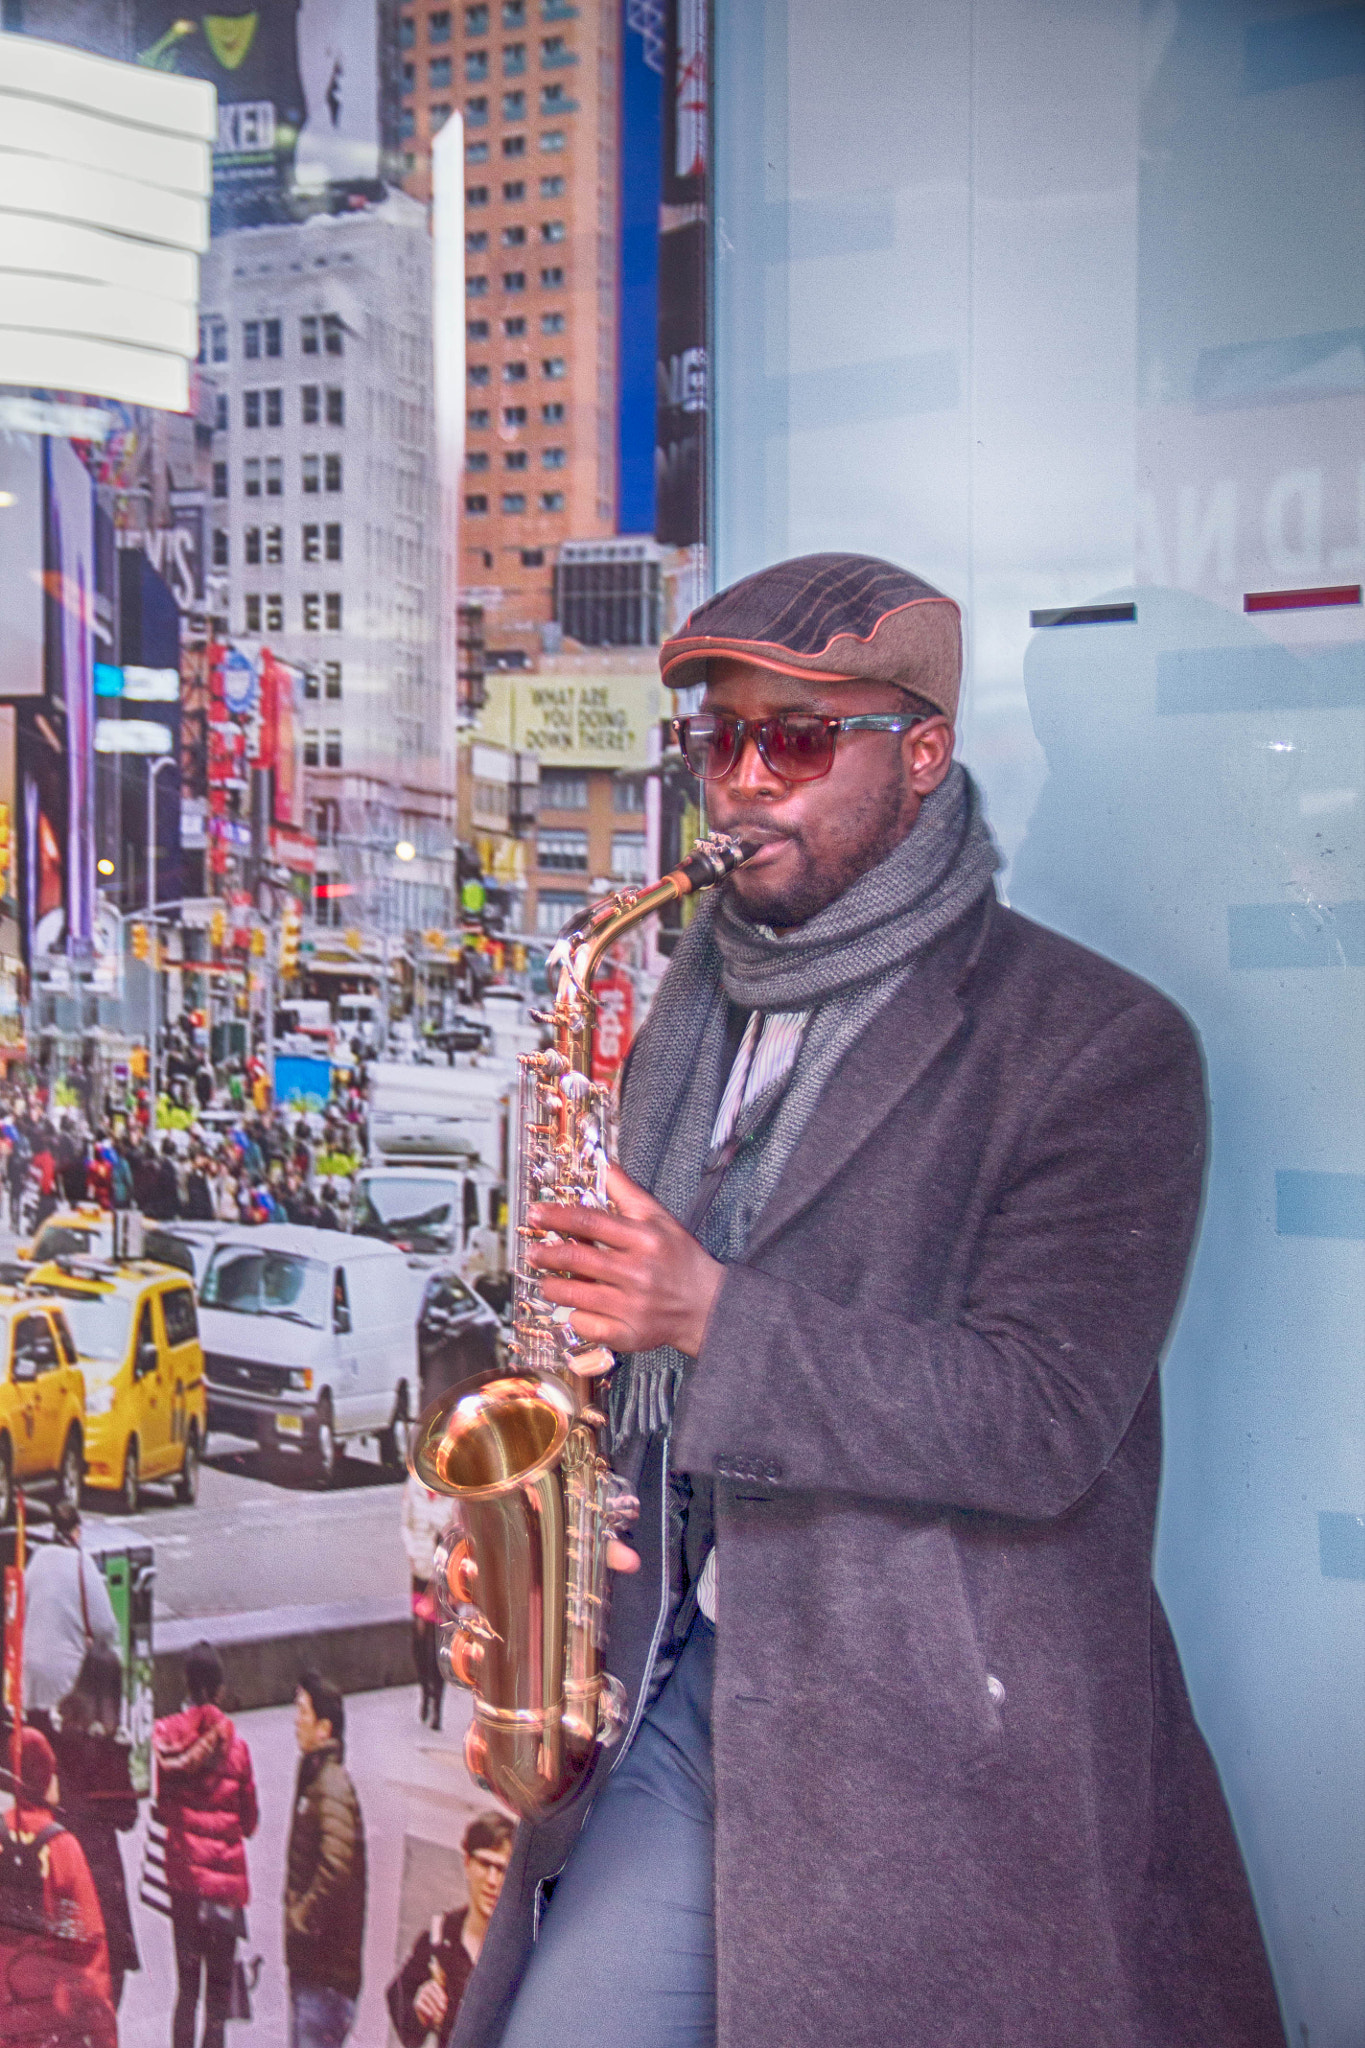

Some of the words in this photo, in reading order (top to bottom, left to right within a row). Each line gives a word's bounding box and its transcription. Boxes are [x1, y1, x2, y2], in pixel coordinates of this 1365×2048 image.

[530, 686, 575, 706] WHAT
[579, 686, 609, 706] ARE
[543, 708, 573, 728] YOU
[578, 707, 627, 729] DOING
[525, 729, 573, 750] DOWN
[577, 729, 636, 751] THERE?
